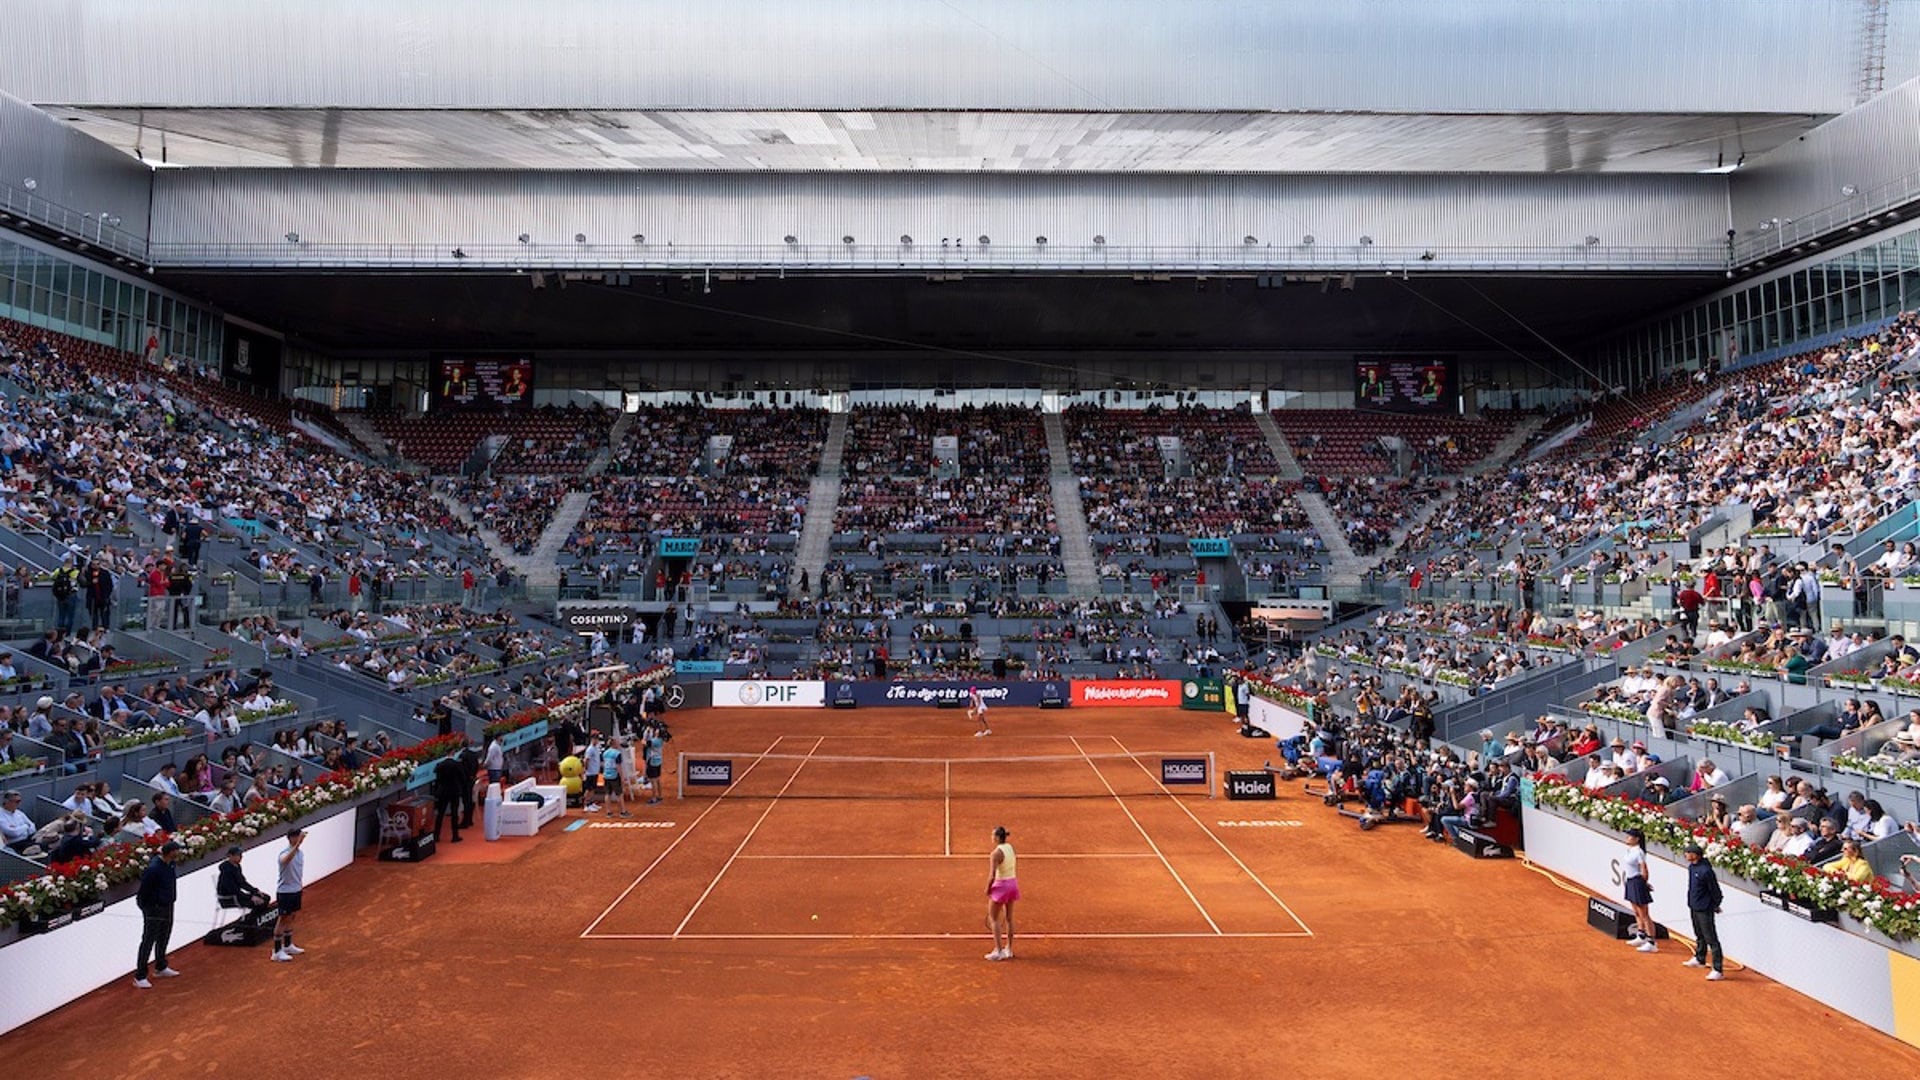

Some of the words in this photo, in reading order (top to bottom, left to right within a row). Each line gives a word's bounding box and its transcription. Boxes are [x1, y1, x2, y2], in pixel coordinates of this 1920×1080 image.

[570, 614, 628, 625] COSENTINO
[765, 686, 797, 702] PIF
[690, 766, 728, 774] HOLOGIC
[1165, 764, 1203, 773] HOLOGIC
[1234, 781, 1271, 794] Haier
[1590, 899, 1616, 920] LACOSTE
